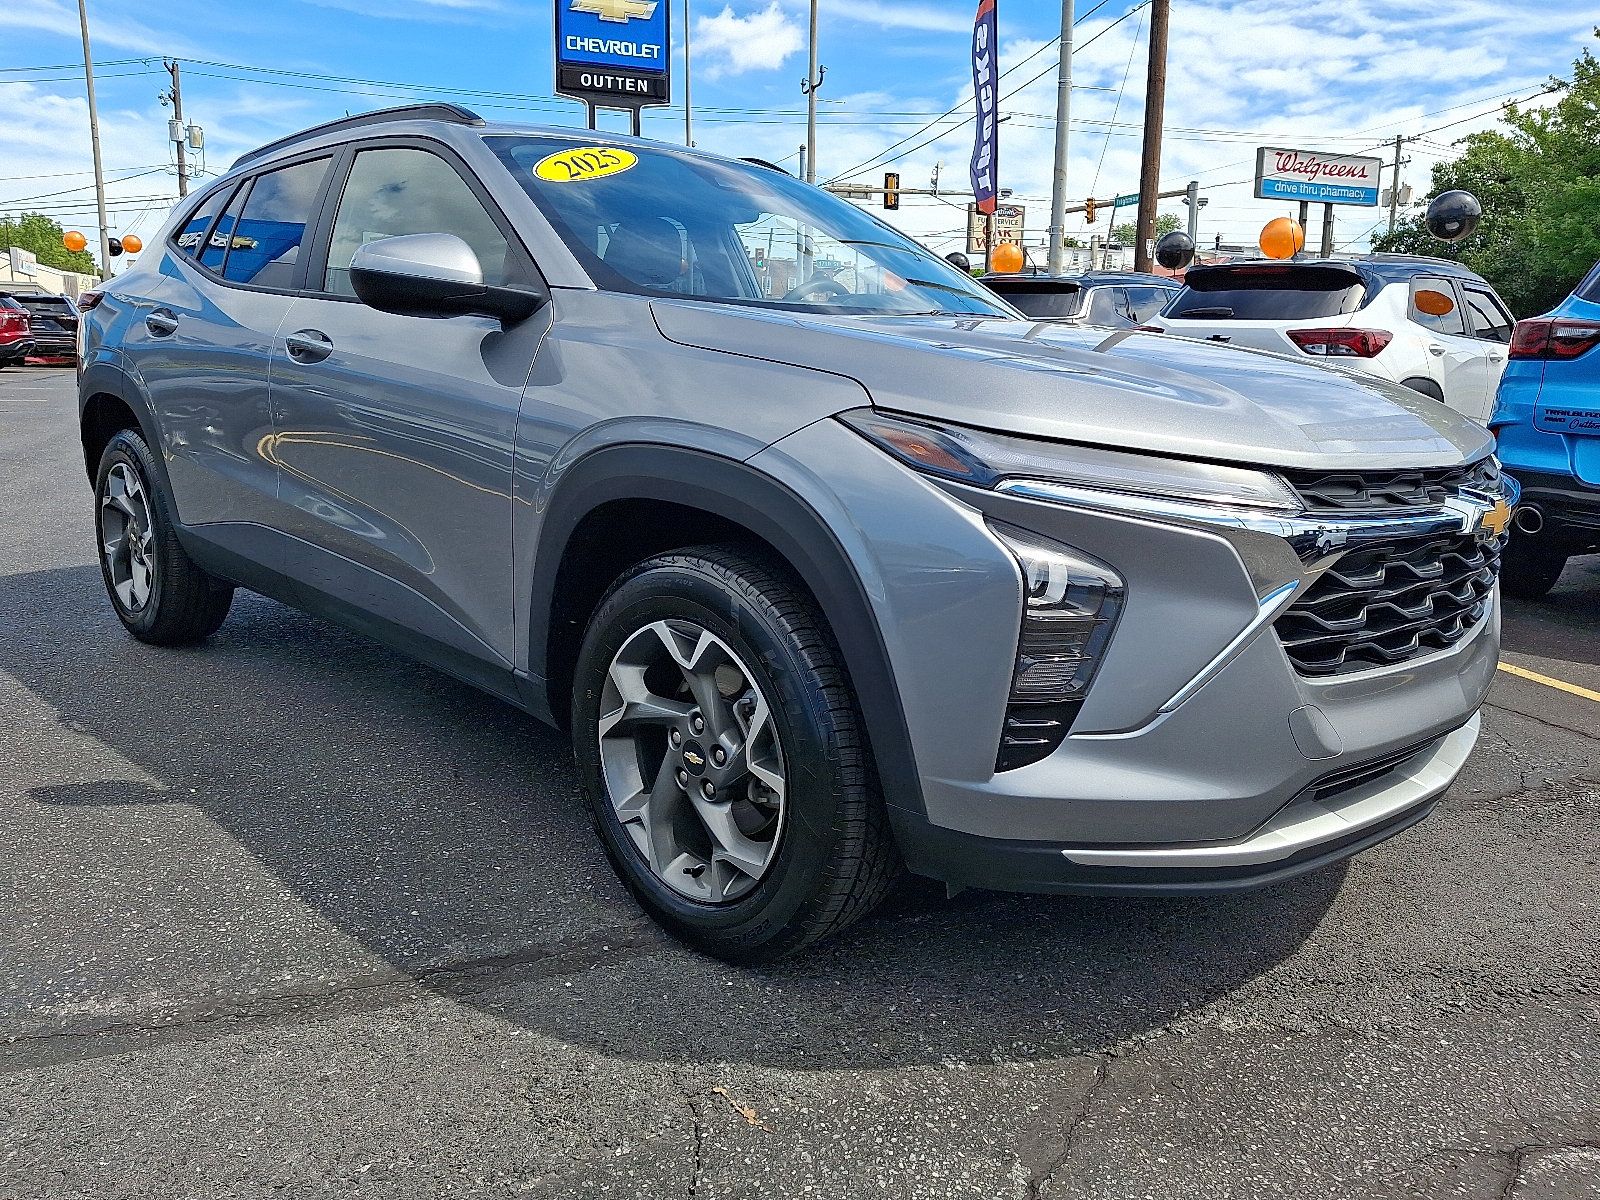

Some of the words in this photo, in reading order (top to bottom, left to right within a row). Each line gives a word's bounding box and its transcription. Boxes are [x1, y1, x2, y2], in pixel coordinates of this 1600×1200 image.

[566, 35, 660, 59] CHEVROLET
[580, 73, 648, 92] OUTTEN
[554, 150, 621, 179] 2025
[1275, 151, 1369, 181] Walgreens
[1274, 182, 1297, 193] drive
[1300, 185, 1317, 194] thru
[1320, 186, 1366, 200] pharmacy
[1544, 408, 1600, 418] TRAILBLAZ
